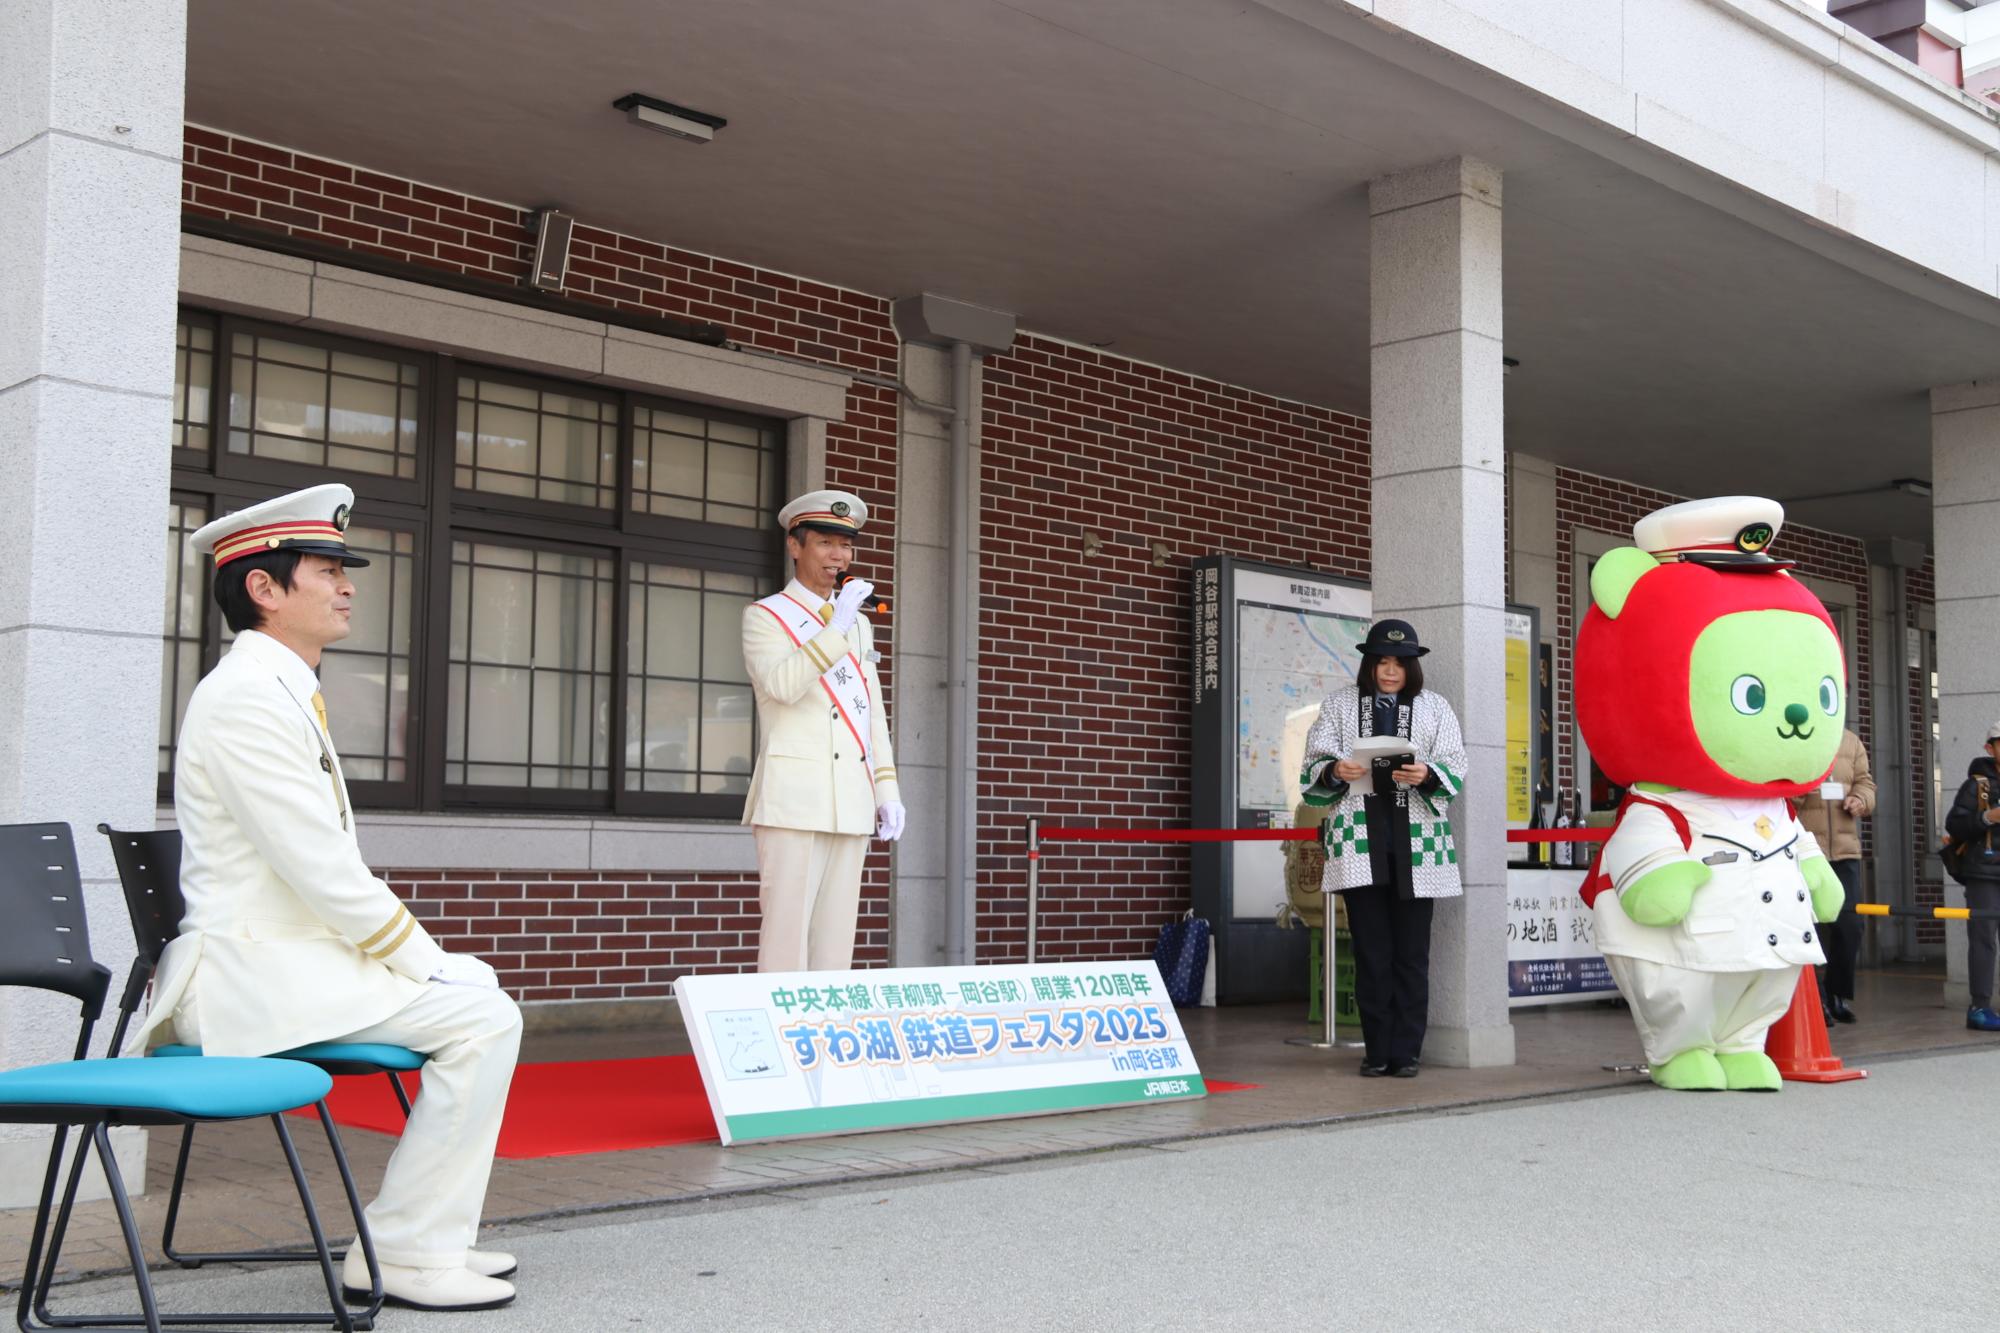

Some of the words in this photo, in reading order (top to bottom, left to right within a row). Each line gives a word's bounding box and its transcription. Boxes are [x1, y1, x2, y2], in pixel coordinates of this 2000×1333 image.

[1195, 569, 1203, 602] Okaya
[1195, 604, 1203, 641] Station
[1204, 568, 1218, 690] 岡谷駅総合案内
[1195, 643, 1203, 704] Information
[1570, 916, 1593, 943] 試
[1109, 1046, 1183, 1072] in岡谷駅
[1143, 1080, 1191, 1097] JR東日本
